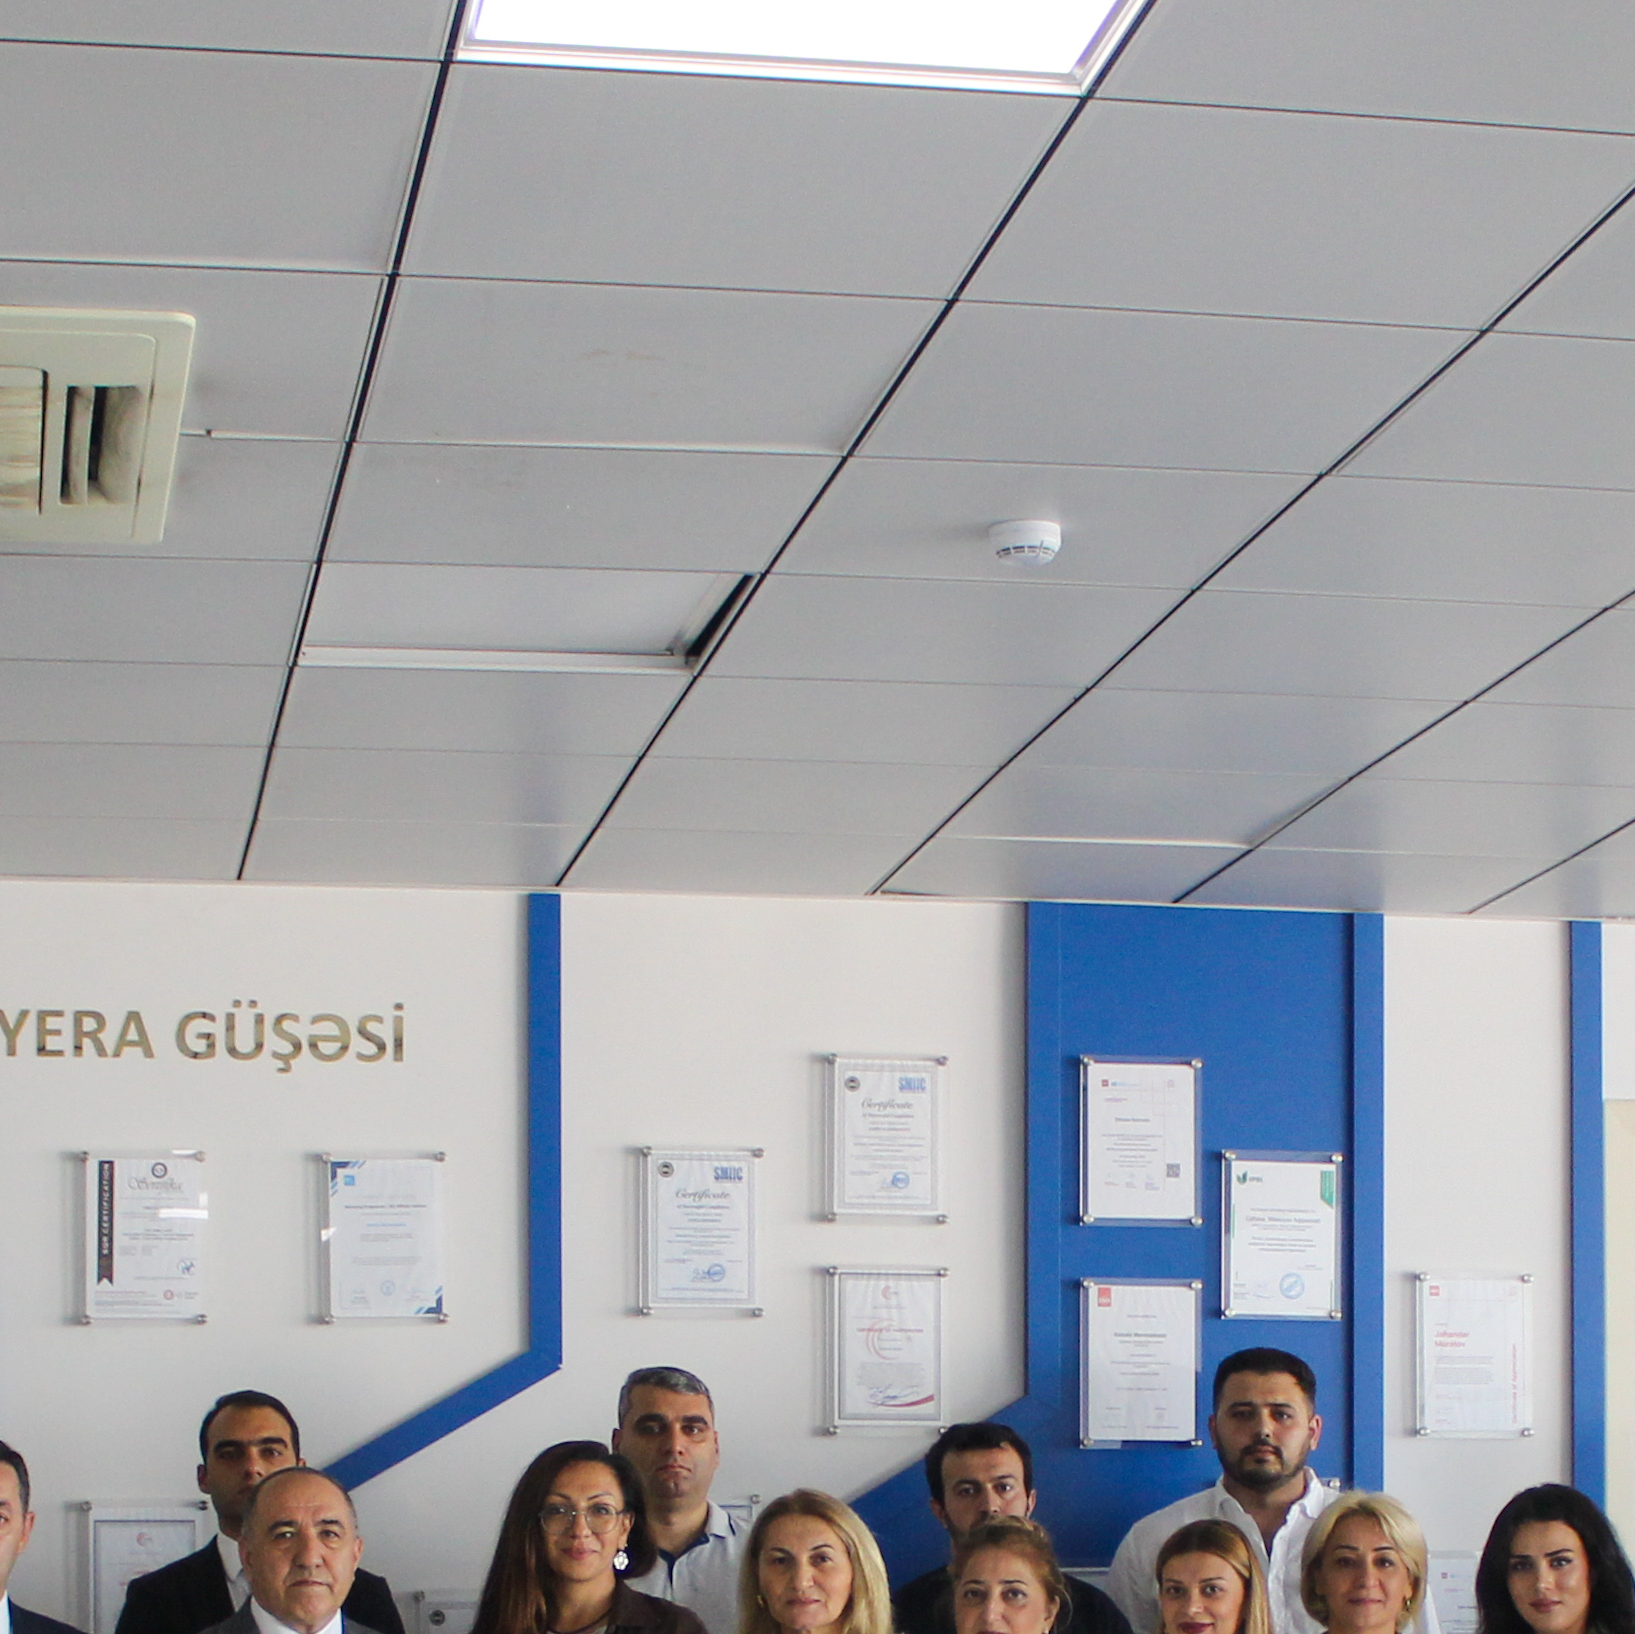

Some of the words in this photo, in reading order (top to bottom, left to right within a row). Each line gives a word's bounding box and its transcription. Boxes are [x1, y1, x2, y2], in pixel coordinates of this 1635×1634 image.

[174, 1001, 405, 1073] GÜŞƏSİ
[713, 1166, 744, 1181] SMIIC
[675, 1187, 730, 1203] Certificate
